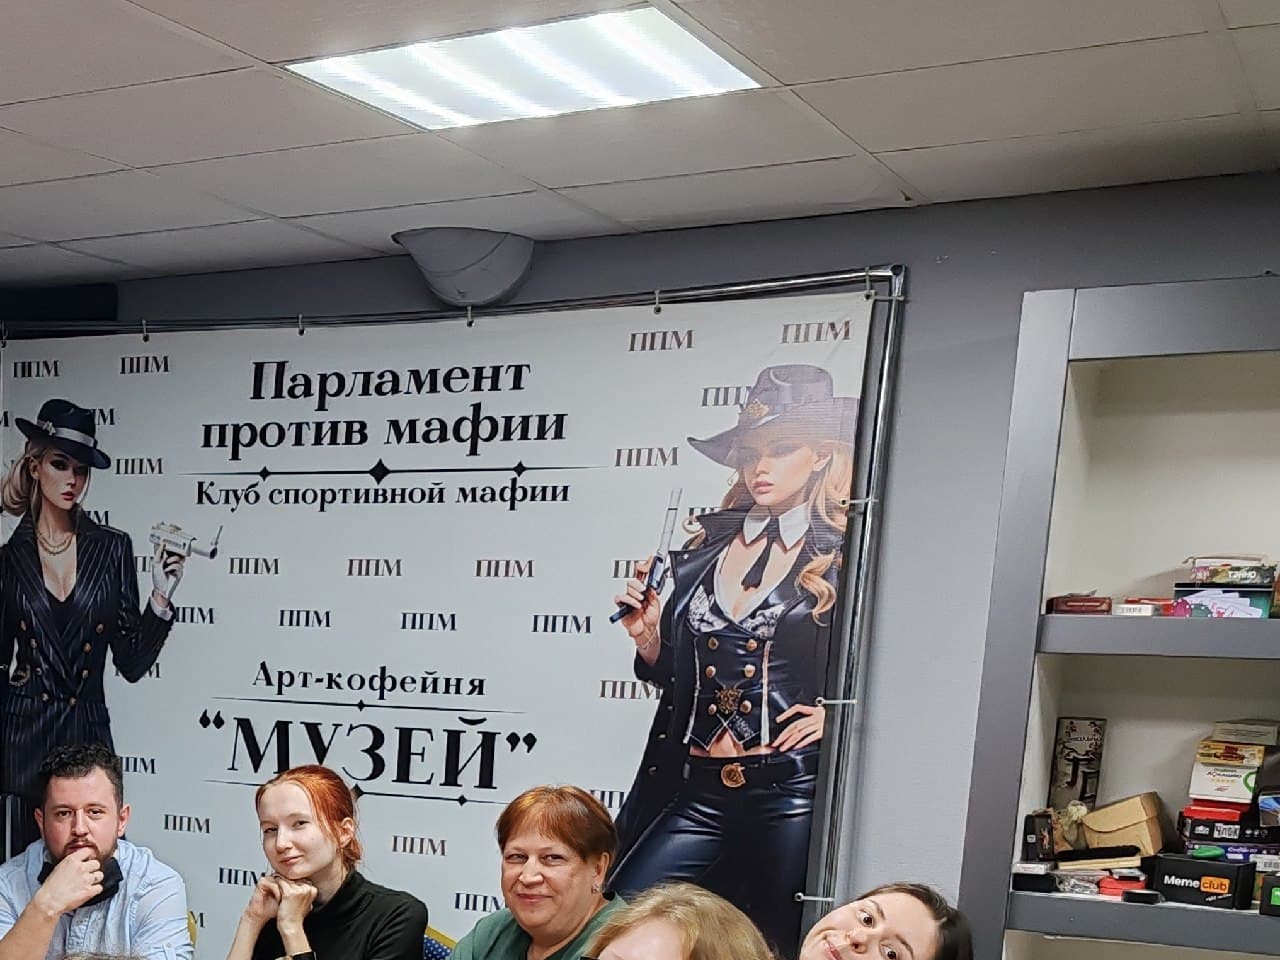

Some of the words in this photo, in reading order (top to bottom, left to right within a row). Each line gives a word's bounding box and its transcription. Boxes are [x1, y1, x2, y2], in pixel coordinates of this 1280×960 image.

[628, 330, 695, 352] ППМ
[781, 320, 852, 344] ППМ
[13, 360, 60, 378] ППМ
[120, 356, 170, 375] ППМ
[250, 361, 531, 411] Парламент
[201, 420, 369, 461] против
[385, 403, 568, 457] мафии
[115, 458, 163, 475] ППМ
[614, 447, 679, 468] ППМ
[196, 480, 260, 513] Клуб
[269, 480, 445, 512] спортивной
[456, 478, 570, 511] мафии
[229, 556, 280, 575] ППМ
[347, 558, 403, 577] ППМ
[474, 559, 535, 578] ППМ
[279, 609, 332, 628] ППМ
[400, 612, 458, 631] ППМ
[531, 614, 592, 634] ППМ
[252, 661, 486, 700] Арт-кофейня
[600, 680, 661, 700] ППМ
[164, 814, 210, 834] ППМ
[392, 834, 447, 857] ППМ
[1163, 875, 1200, 888] Meme
[1202, 880, 1228, 892] club
